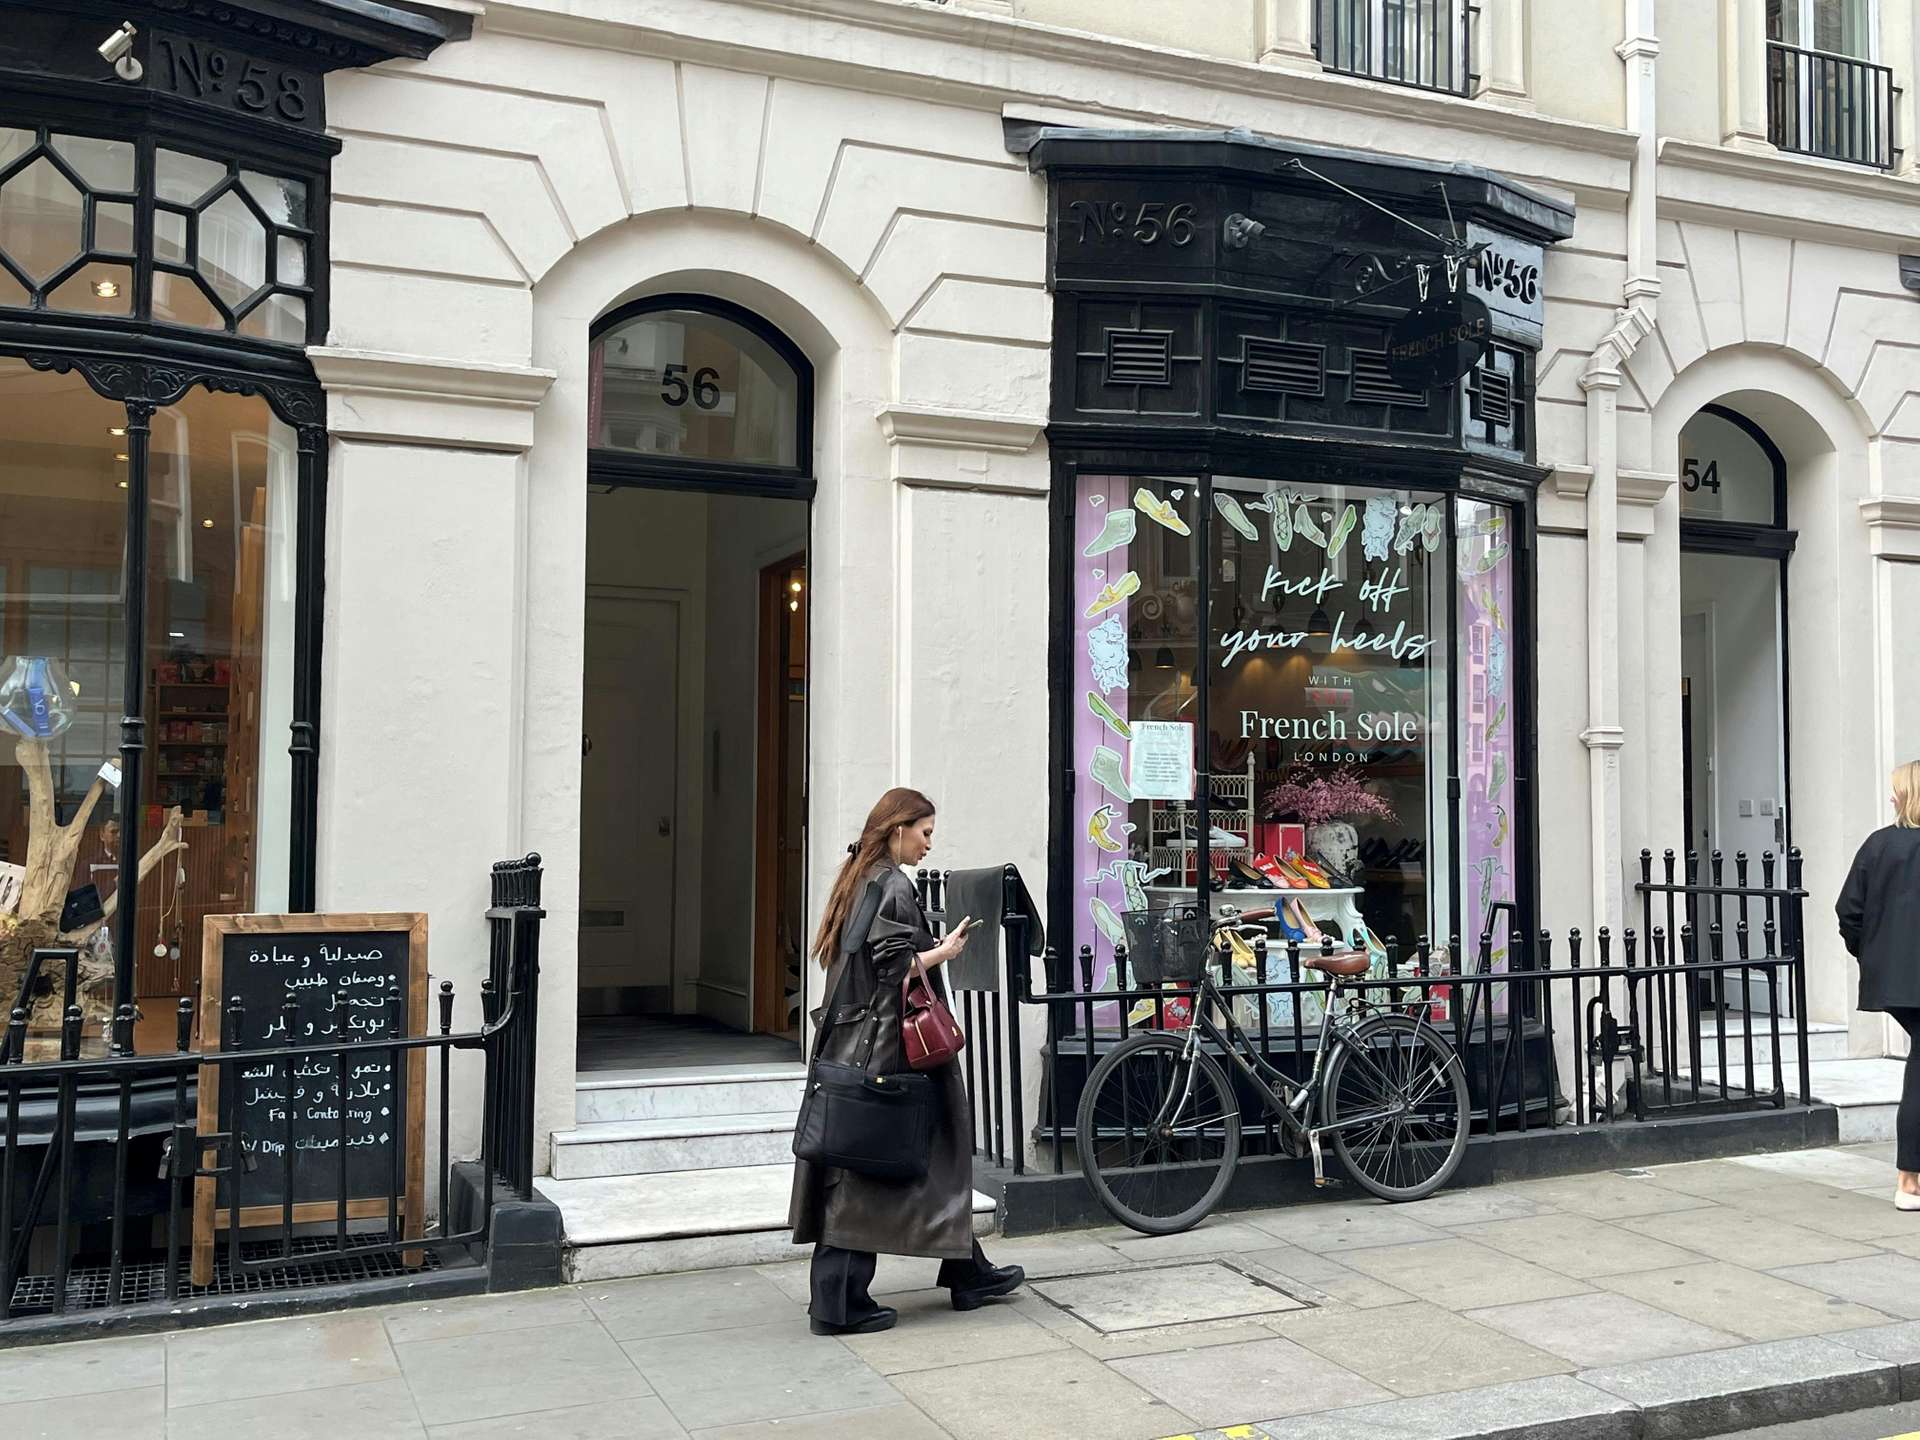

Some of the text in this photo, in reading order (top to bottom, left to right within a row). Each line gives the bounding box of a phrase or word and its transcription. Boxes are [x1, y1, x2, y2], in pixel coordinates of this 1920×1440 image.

[235, 60, 306, 123] 58
[1132, 202, 1198, 246] 56
[1448, 317, 1486, 345] SOLE
[660, 363, 720, 410] 56
[1682, 458, 1721, 494] 54
[1359, 567, 1409, 613] off
[1220, 610, 1438, 668] your heels
[1308, 675, 1351, 686] WITH
[1239, 710, 1418, 742] French Sole
[1294, 752, 1369, 763] LONDON
[319, 943, 383, 965] صيدلية
[306, 1106, 372, 1124] Contoring
